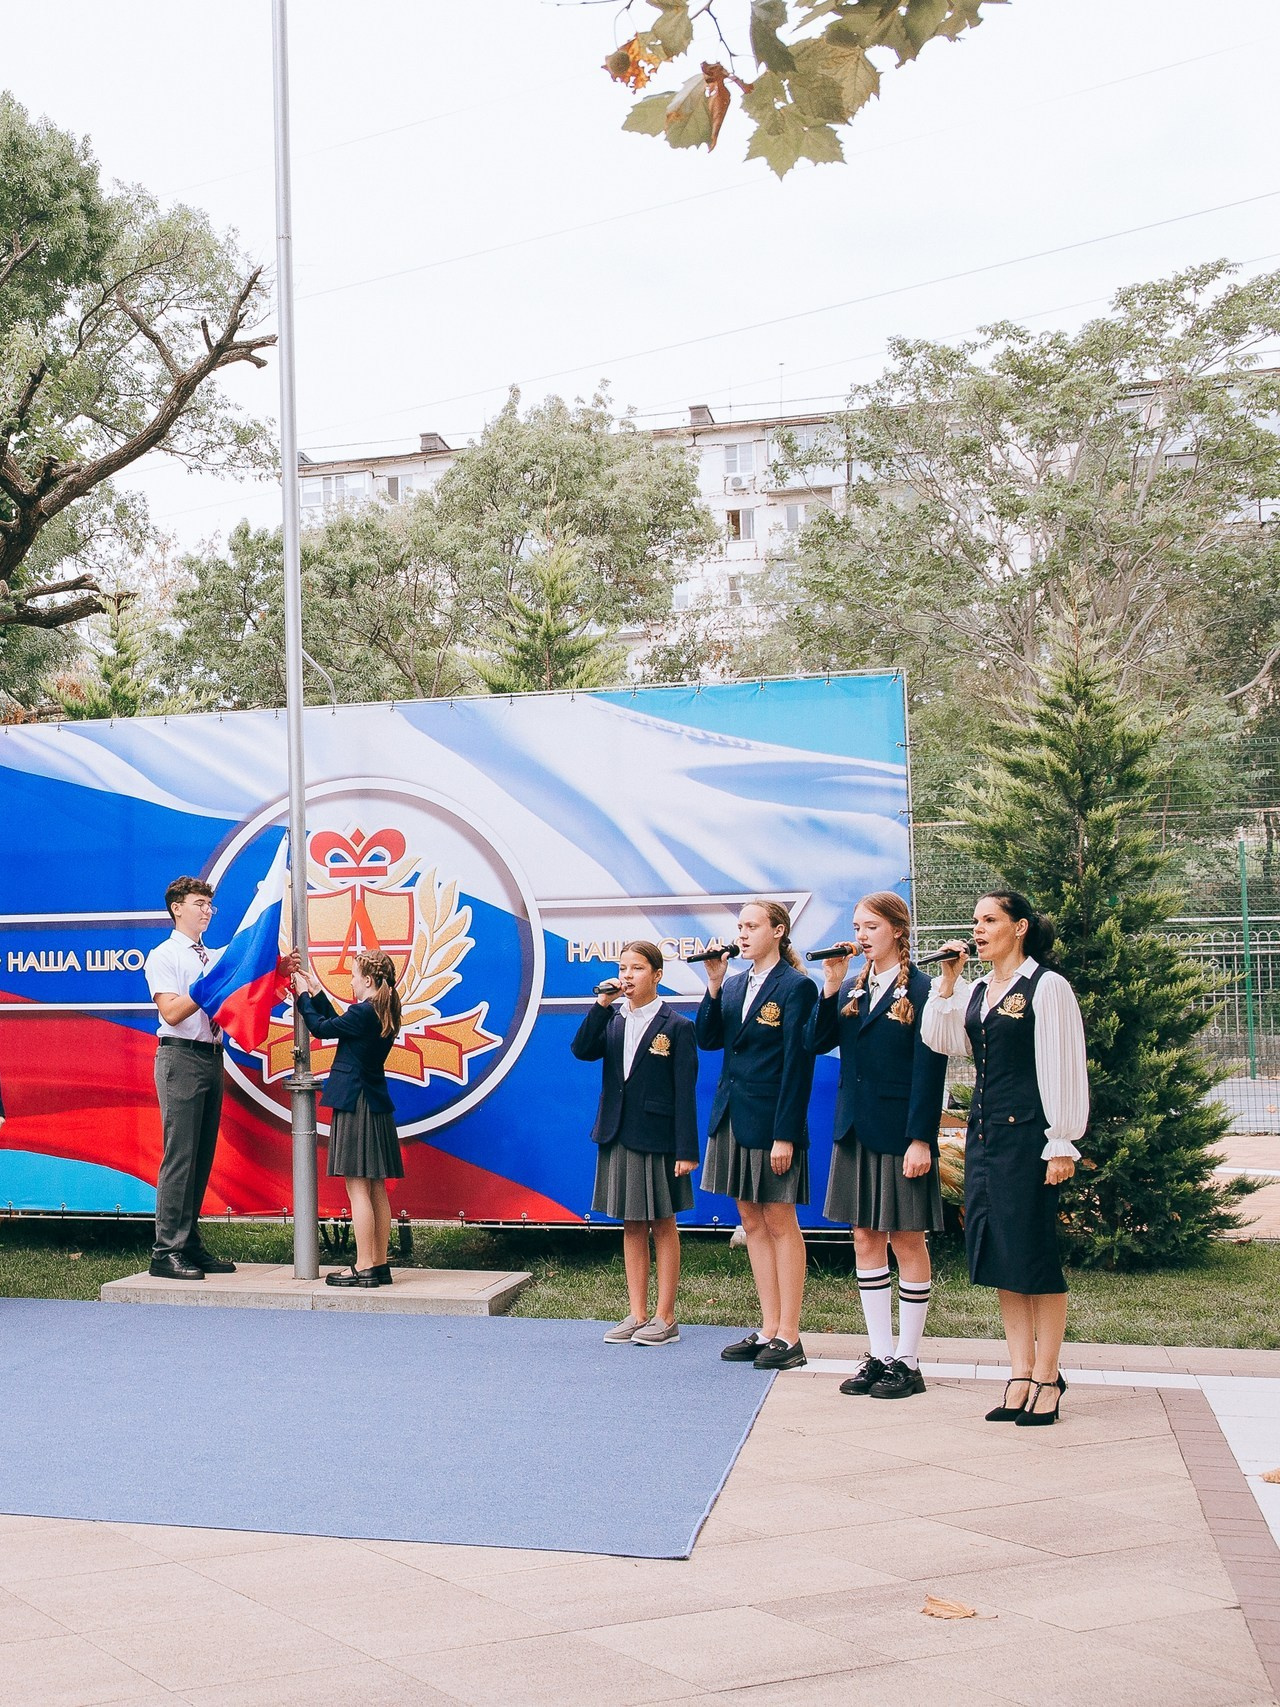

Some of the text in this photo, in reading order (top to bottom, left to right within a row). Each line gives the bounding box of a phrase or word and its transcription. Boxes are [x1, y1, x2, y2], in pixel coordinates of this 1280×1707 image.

[7, 948, 152, 973] НАША ШКО
[567, 936, 741, 963] НАШ СЕМ
